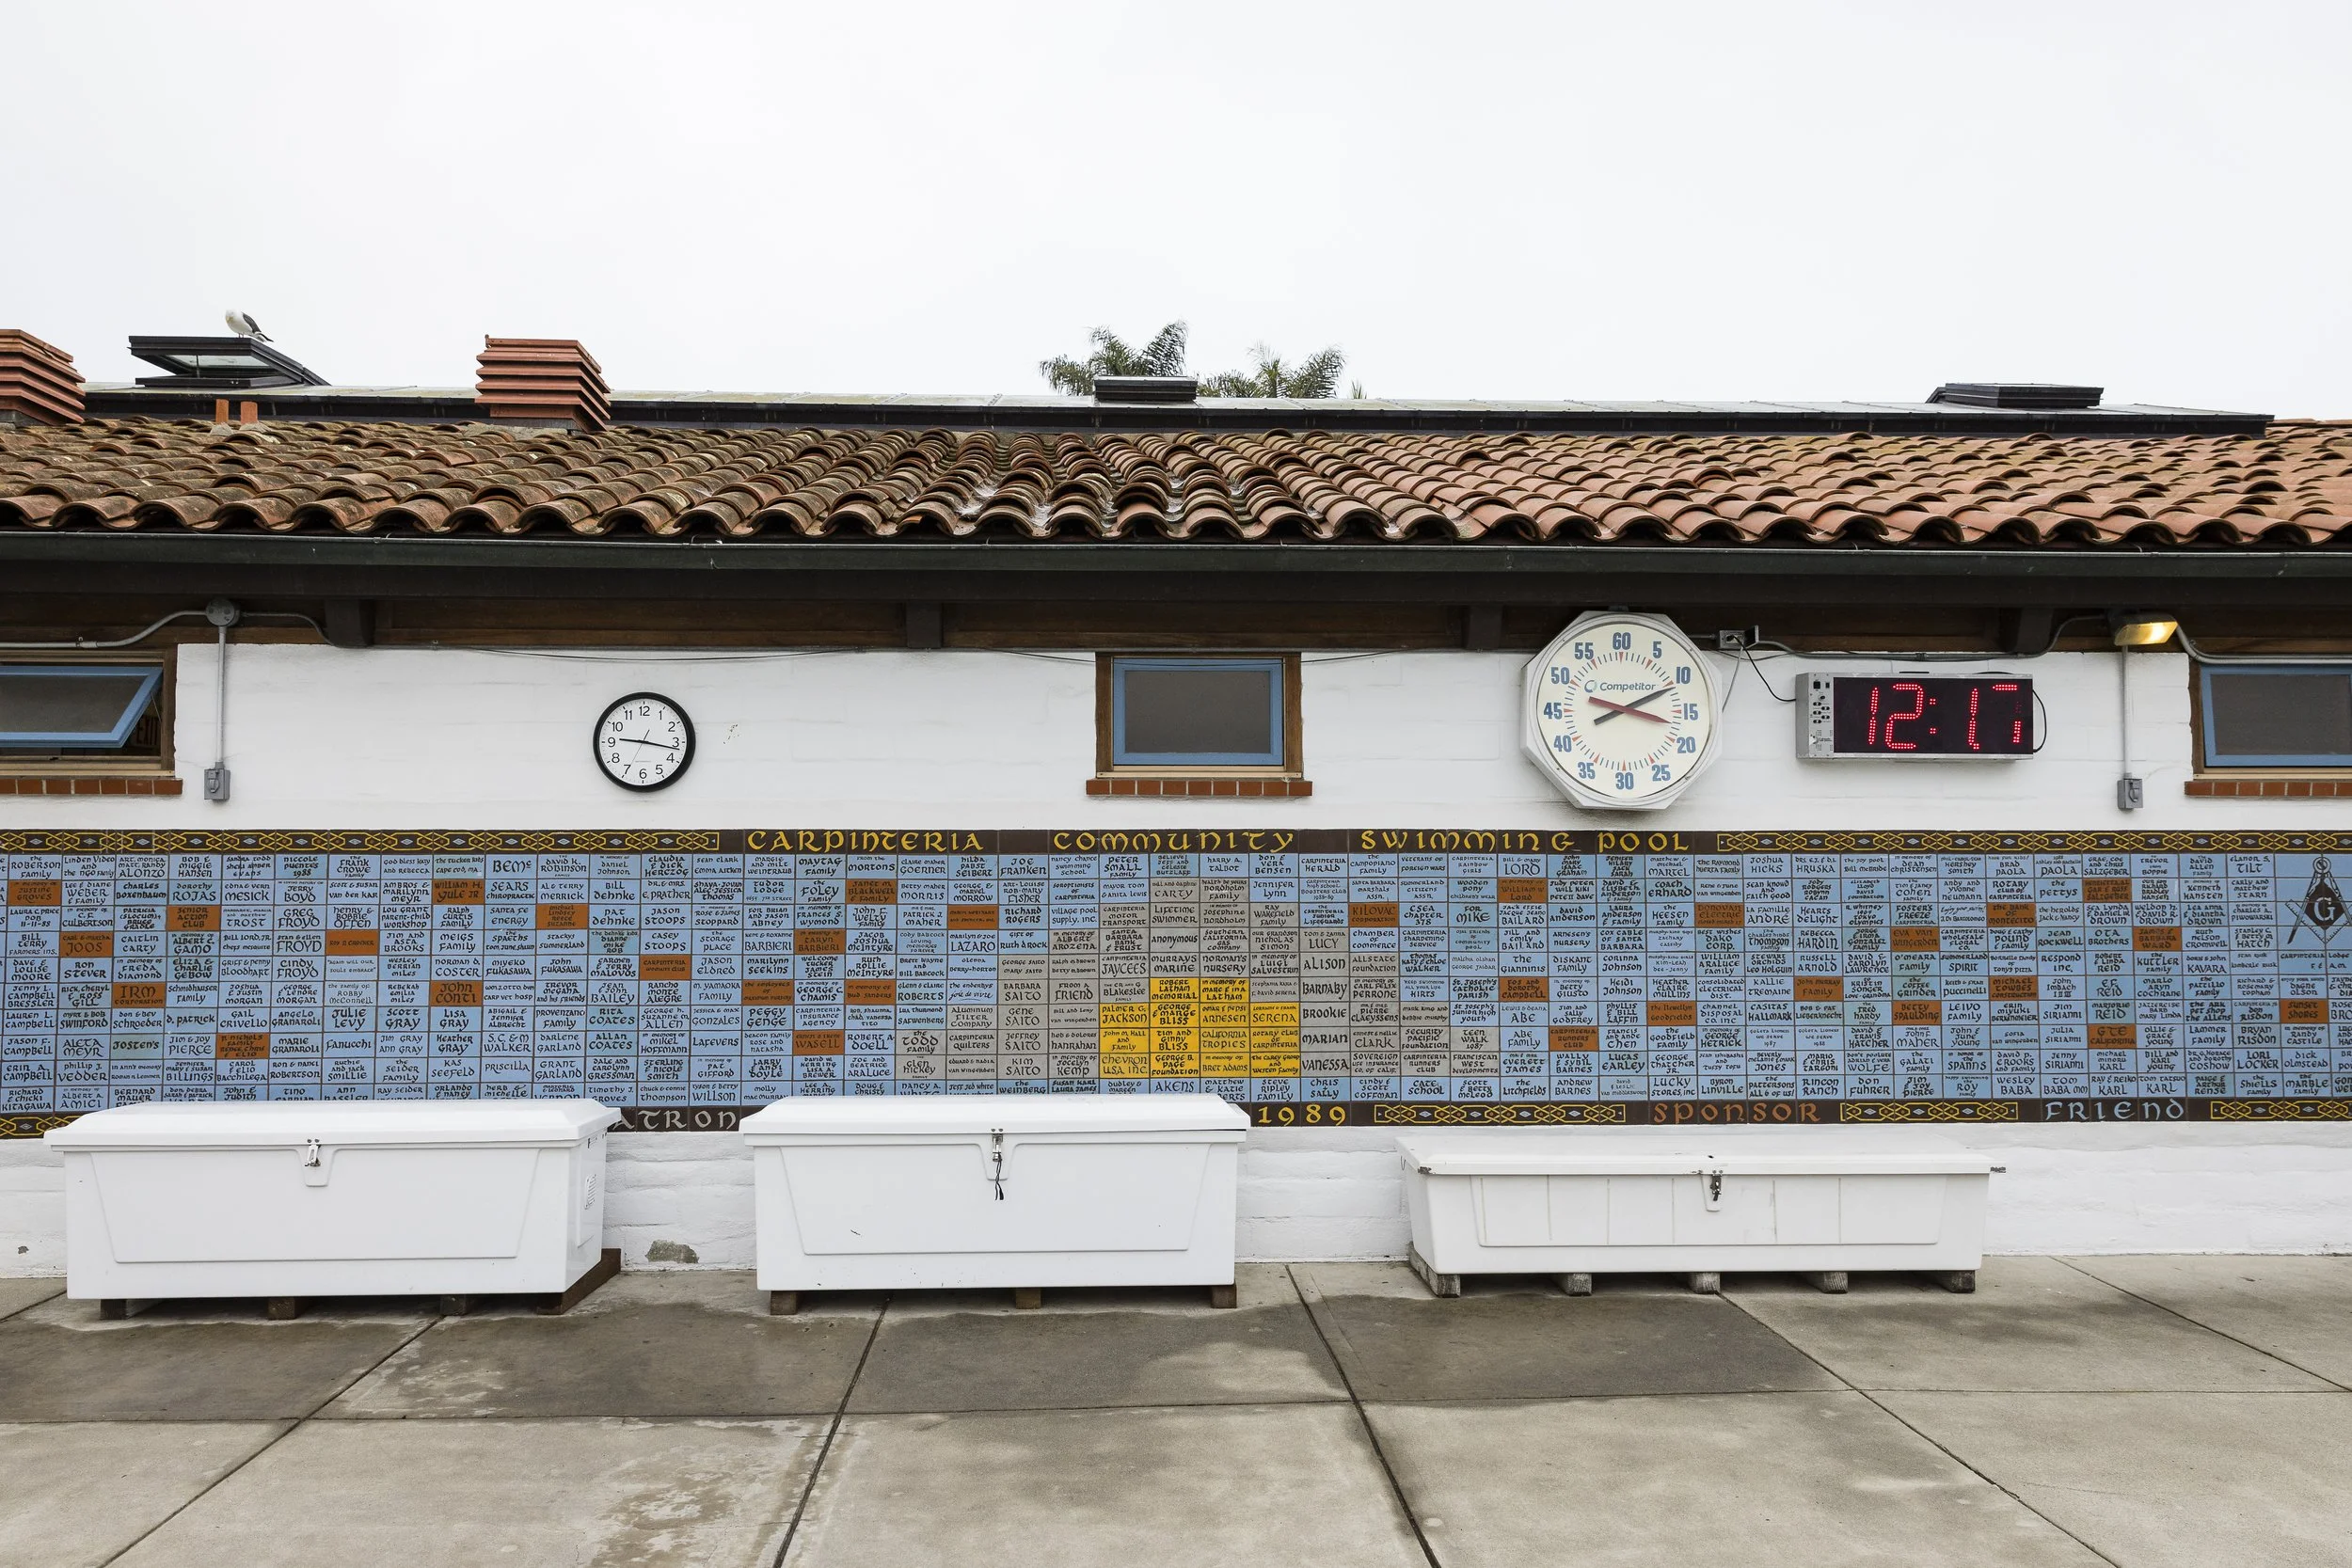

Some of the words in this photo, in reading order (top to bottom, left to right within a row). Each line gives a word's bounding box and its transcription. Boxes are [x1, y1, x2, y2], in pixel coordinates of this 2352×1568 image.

[1612, 632, 1631, 650] 60
[1574, 642, 1595, 660] 55
[1652, 641, 1662, 658] 5
[1551, 667, 1570, 684] 50
[1676, 667, 1691, 684] 10
[1599, 682, 1657, 692] Competitor
[625, 710, 633, 721] 11
[639, 705, 650, 716] 12
[659, 710, 662, 721] 1
[1544, 703, 1563, 720] 45
[1683, 704, 1699, 721] 15
[612, 721, 624, 733] 10
[668, 721, 676, 733] 2
[608, 736, 616, 748] 9
[673, 737, 680, 748] 3
[1554, 736, 1573, 752] 40
[1677, 736, 1696, 753] 20
[612, 752, 621, 764] 8
[666, 752, 675, 764] 4
[624, 765, 632, 775] 7
[640, 769, 647, 780] 6
[656, 765, 664, 775] 5
[1578, 762, 1597, 780] 35
[1652, 765, 1671, 782] 25
[1615, 772, 1634, 790] 30
[1597, 832, 1689, 853] POOL
[68, 889, 109, 897] WEBER
[173, 892, 216, 901] ROJAS
[2313, 897, 2336, 920] G
[950, 942, 995, 952] LAZARO
[1310, 939, 1339, 949] LUCY
[64, 969, 105, 978] STEVER
[591, 994, 634, 1005] BAILEY
[898, 992, 944, 1001] ROBERTS
[1006, 992, 1041, 1001] SAITO
[2237, 1060, 2279, 1069] LOCKER
[2001, 1086, 2032, 1095] BABA
[1259, 1104, 1346, 1126] 1989
[1654, 1102, 1820, 1125] SPONSOR
